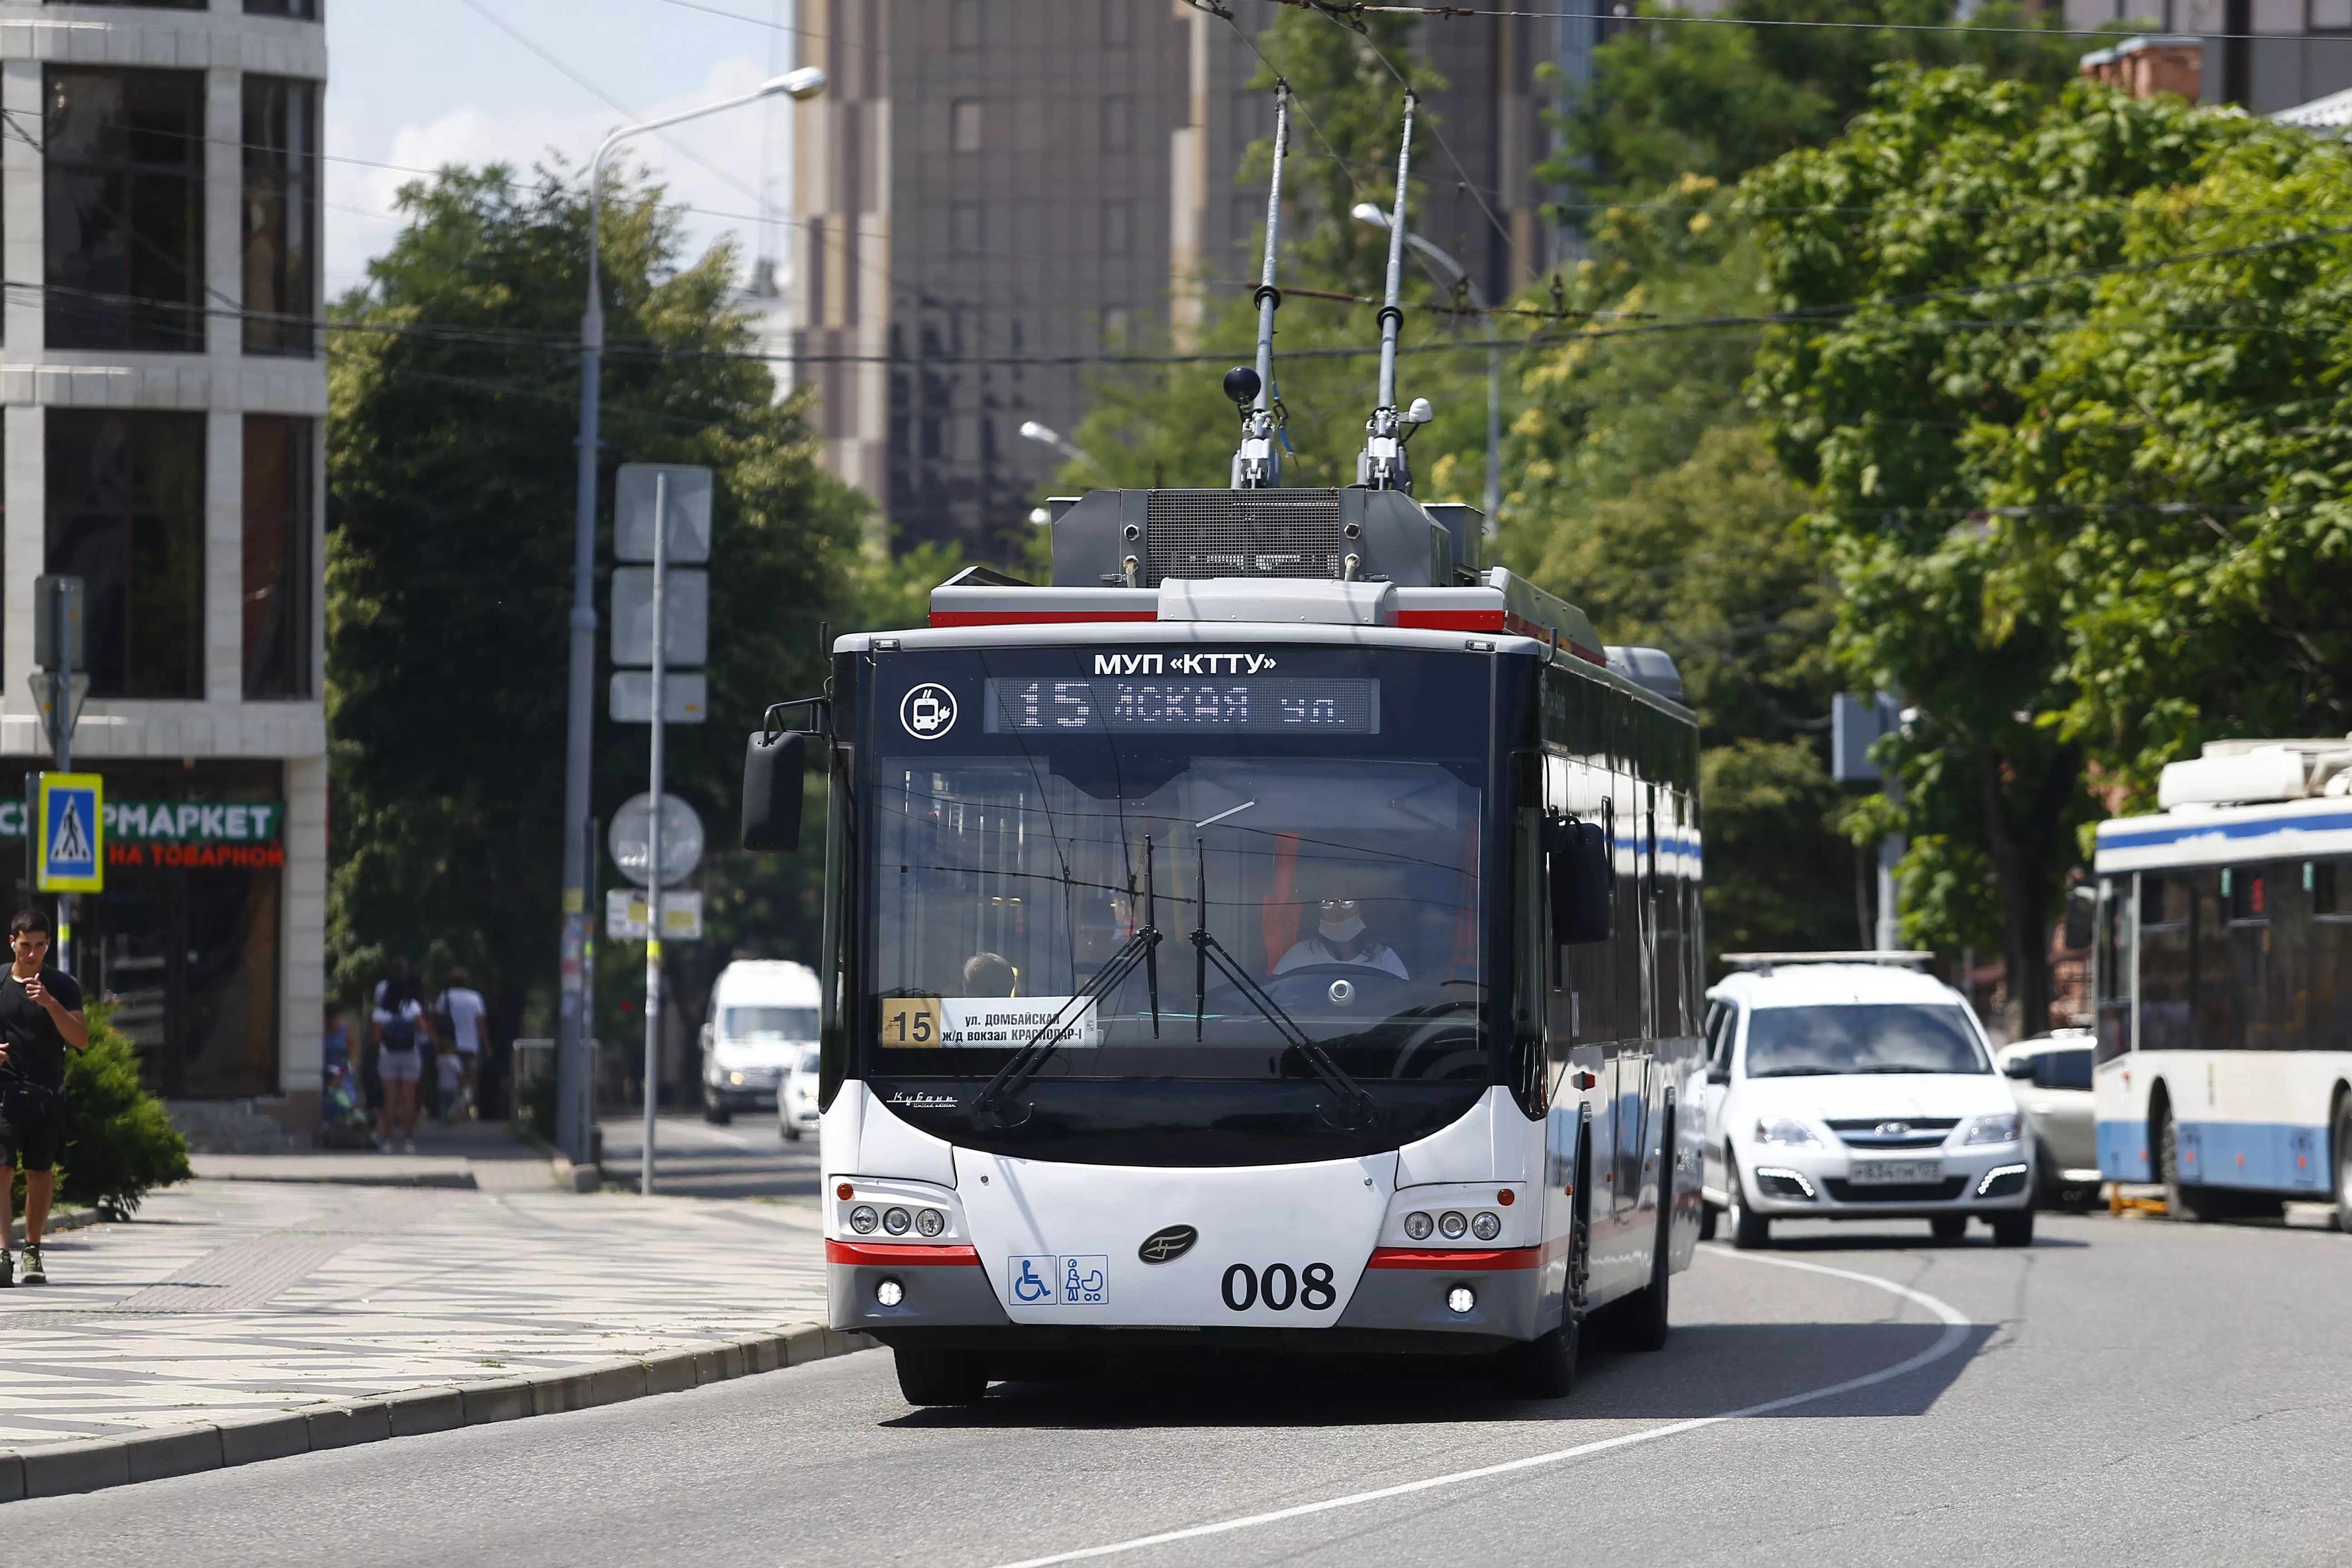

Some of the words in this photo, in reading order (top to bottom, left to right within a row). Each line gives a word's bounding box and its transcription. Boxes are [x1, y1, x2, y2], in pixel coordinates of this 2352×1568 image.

[1095, 654, 1163, 675] МУП
[1170, 653, 1277, 674] «КТТУ»
[1020, 681, 1089, 727] 15
[0, 802, 272, 839] СРМАРКЕТ
[109, 844, 142, 867] НА
[151, 839, 285, 867] ТОВАРНОЙ
[893, 1012, 931, 1042] 15
[965, 1016, 981, 1027] ул.
[985, 1012, 1059, 1027] ДОМБАЙСКАЯ
[942, 1030, 963, 1043] ж/д
[967, 1031, 1007, 1041] вокзал
[888, 1092, 957, 1106] Кубань
[1221, 1263, 1337, 1312] 008
